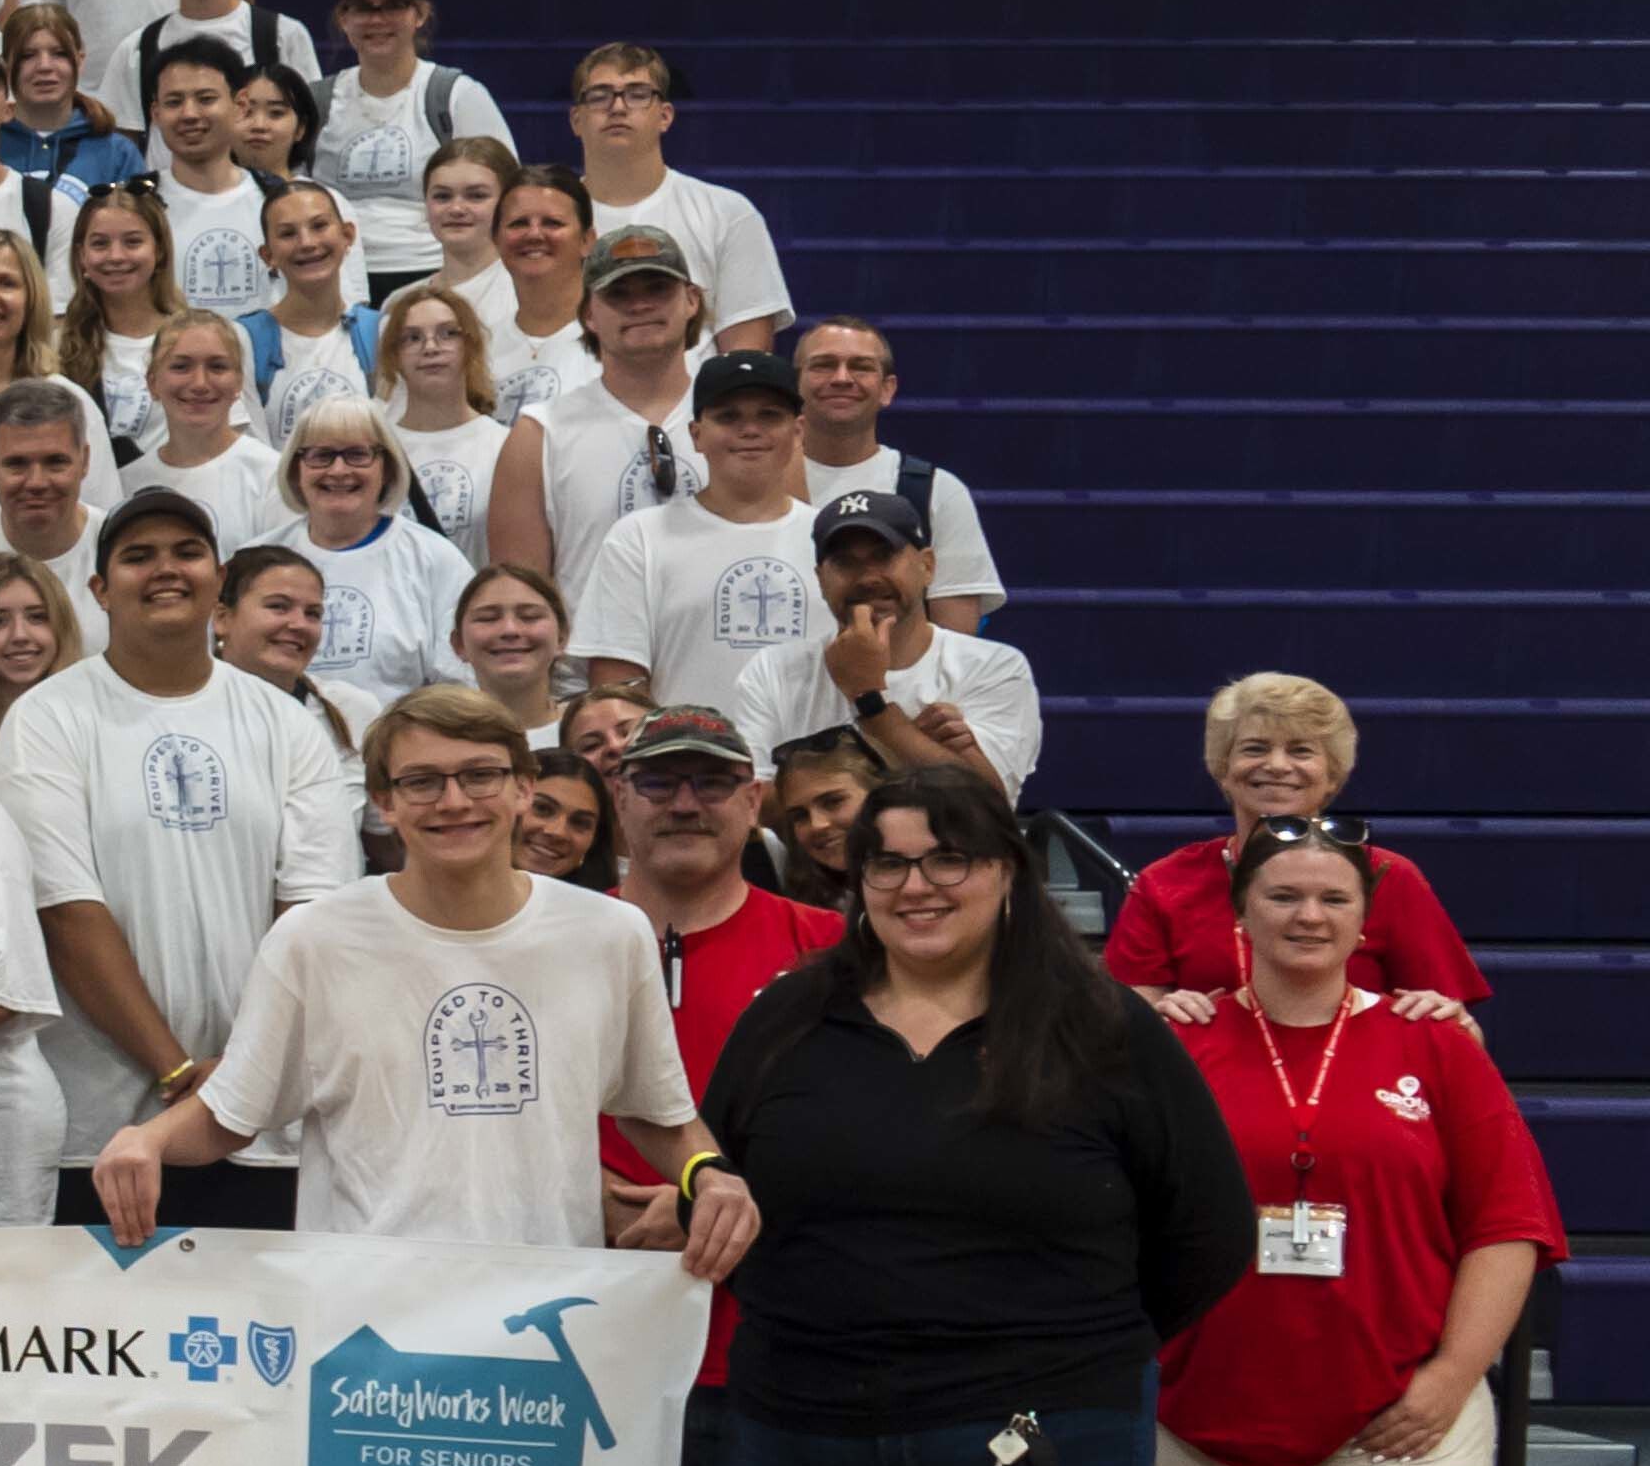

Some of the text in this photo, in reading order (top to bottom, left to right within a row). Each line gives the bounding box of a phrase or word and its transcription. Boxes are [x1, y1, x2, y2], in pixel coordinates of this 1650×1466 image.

[721, 563, 800, 637] EQUIPPED TO THRIVE
[180, 741, 199, 752] TO
[205, 756, 220, 811] THRIVE
[433, 992, 531, 1098] EQUIPPED TO THRIVE
[453, 1084, 470, 1094] 20
[330, 1376, 566, 1429] SafetyWorks Week
[360, 1445, 412, 1466] FOR
